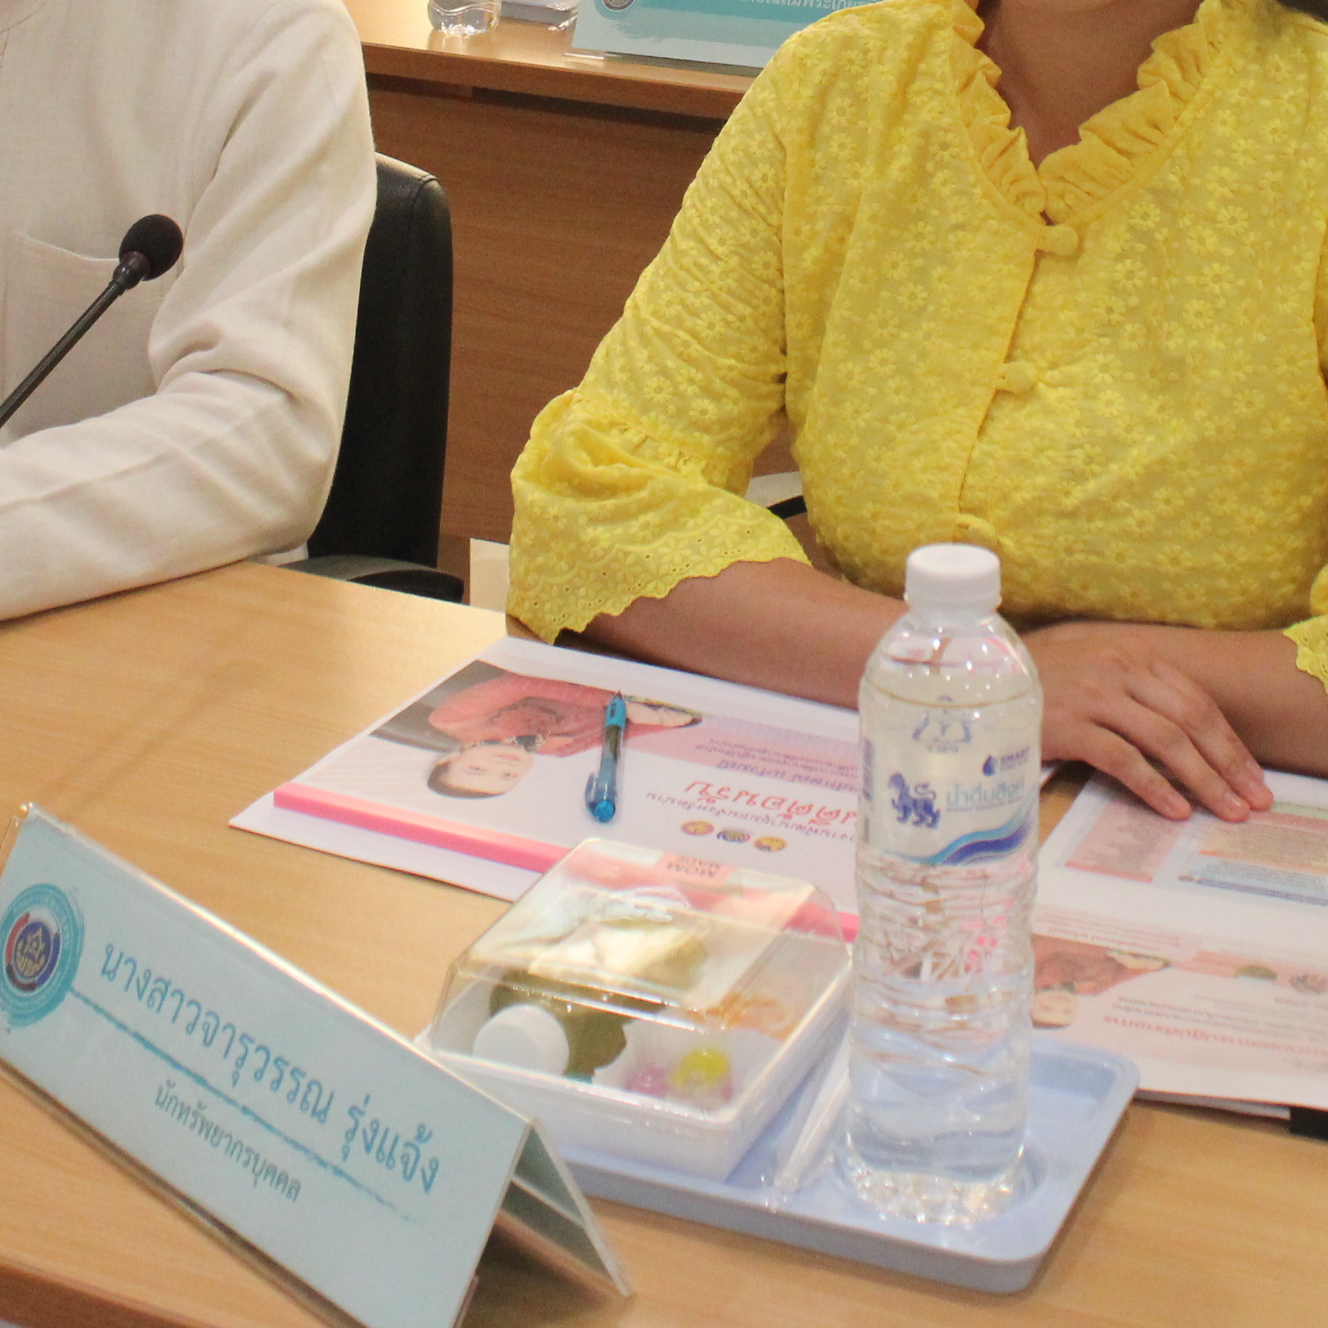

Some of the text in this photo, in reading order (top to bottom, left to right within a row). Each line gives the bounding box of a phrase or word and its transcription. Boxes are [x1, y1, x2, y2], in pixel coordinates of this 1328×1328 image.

[666, 862, 717, 878] MOM
[100, 942, 335, 1125] นางสาวจารุวรรณ
[341, 1093, 439, 1194] รุ่งแจ้ง
[154, 1079, 302, 1202] นักทรัพยากรบุคคล
